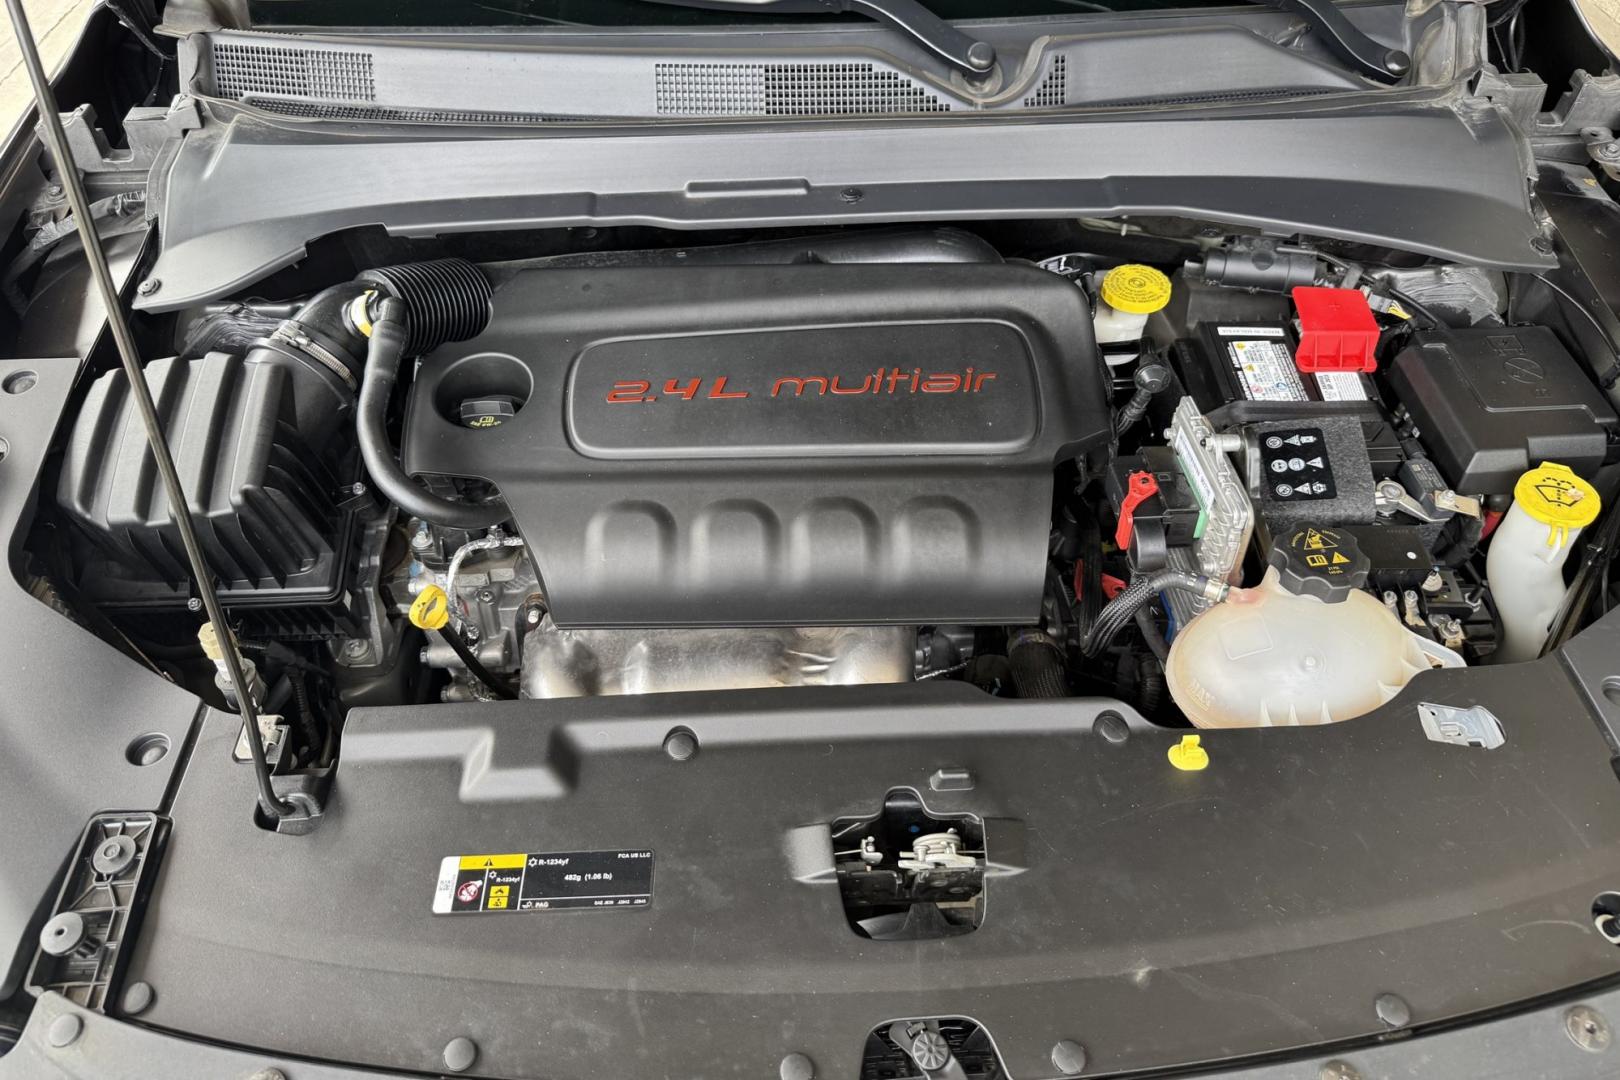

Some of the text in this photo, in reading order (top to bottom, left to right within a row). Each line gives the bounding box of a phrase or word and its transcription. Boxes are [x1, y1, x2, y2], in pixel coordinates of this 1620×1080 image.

[606, 367, 997, 403] 2.4L multiair
[538, 858, 570, 866] R-1234yf
